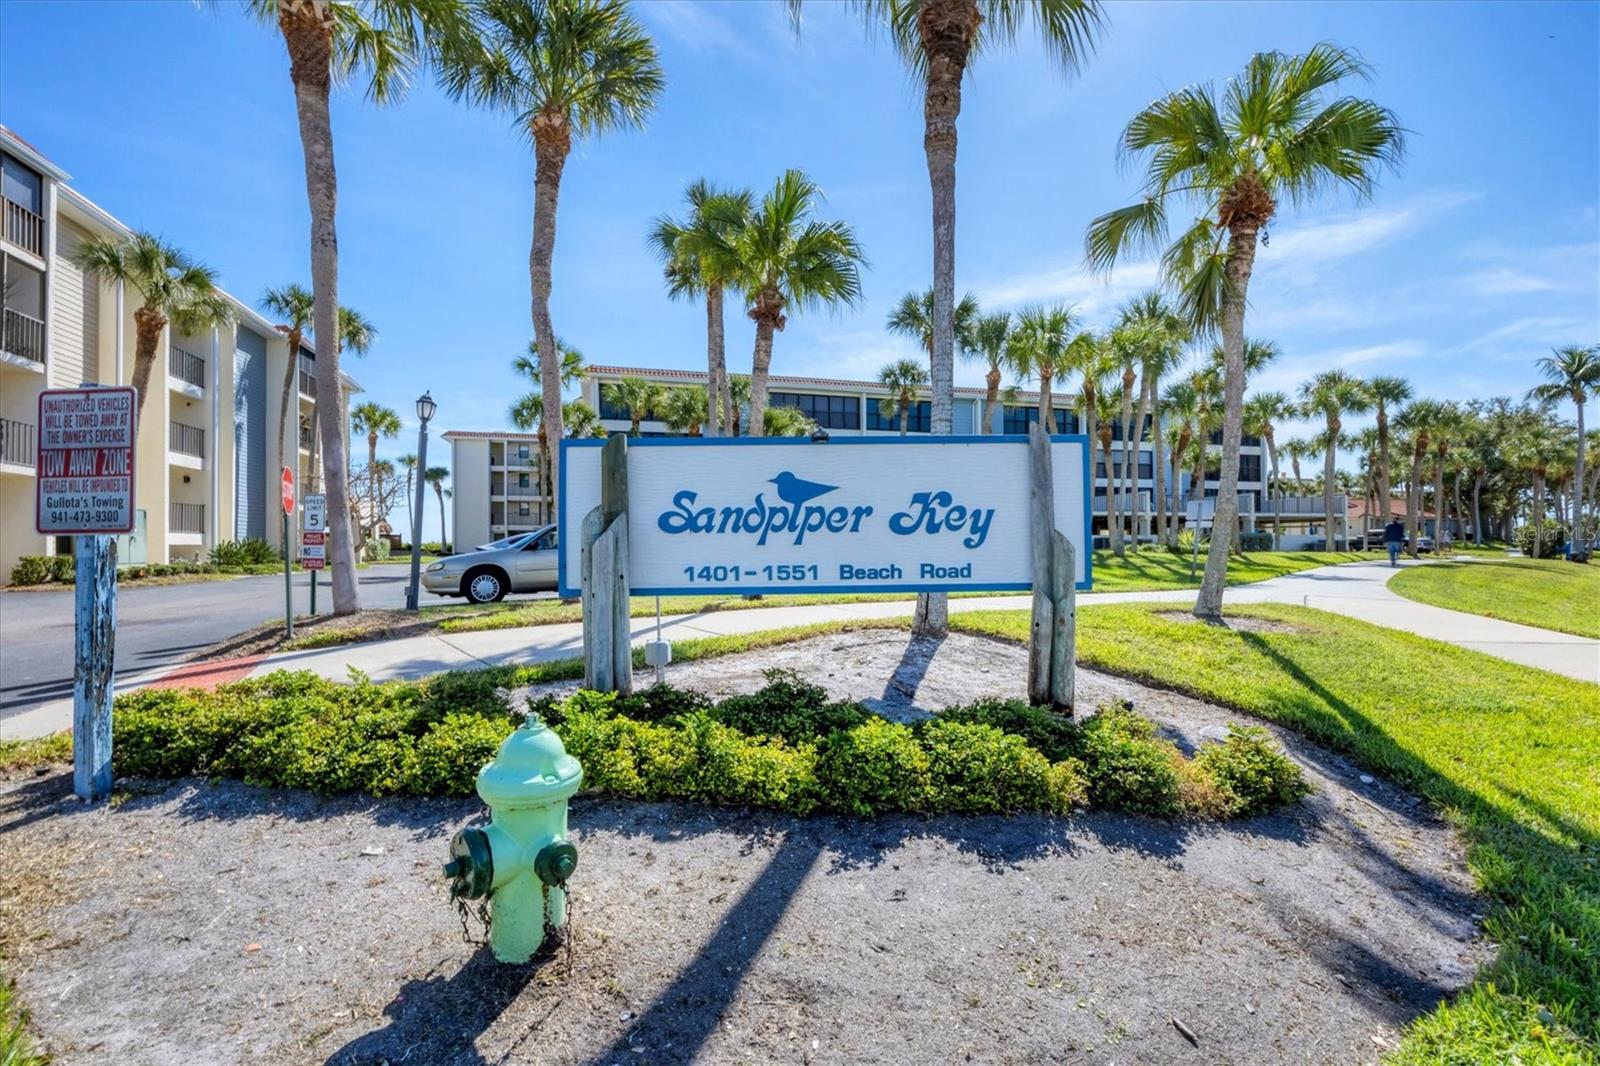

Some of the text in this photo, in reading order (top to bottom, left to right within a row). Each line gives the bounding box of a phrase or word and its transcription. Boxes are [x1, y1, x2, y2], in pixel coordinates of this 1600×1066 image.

[44, 397, 129, 413] UNAUTHORIZED VEHICLES
[46, 413, 128, 428] WILL BE TOWED AWAY AT
[47, 428, 125, 444] THE OWNER'S EXPENSE
[41, 449, 130, 476] TOW AWAY ZONE
[42, 478, 128, 493] VEHICLES WILL BE IMPOUNDED TO
[46, 495, 124, 510] Gullota's Towing
[51, 510, 119, 524] 941-473-9300
[310, 514, 318, 526] 5
[657, 490, 996, 549] Sandpiper Key
[683, 563, 972, 582] 1401-1551 Beach Road
